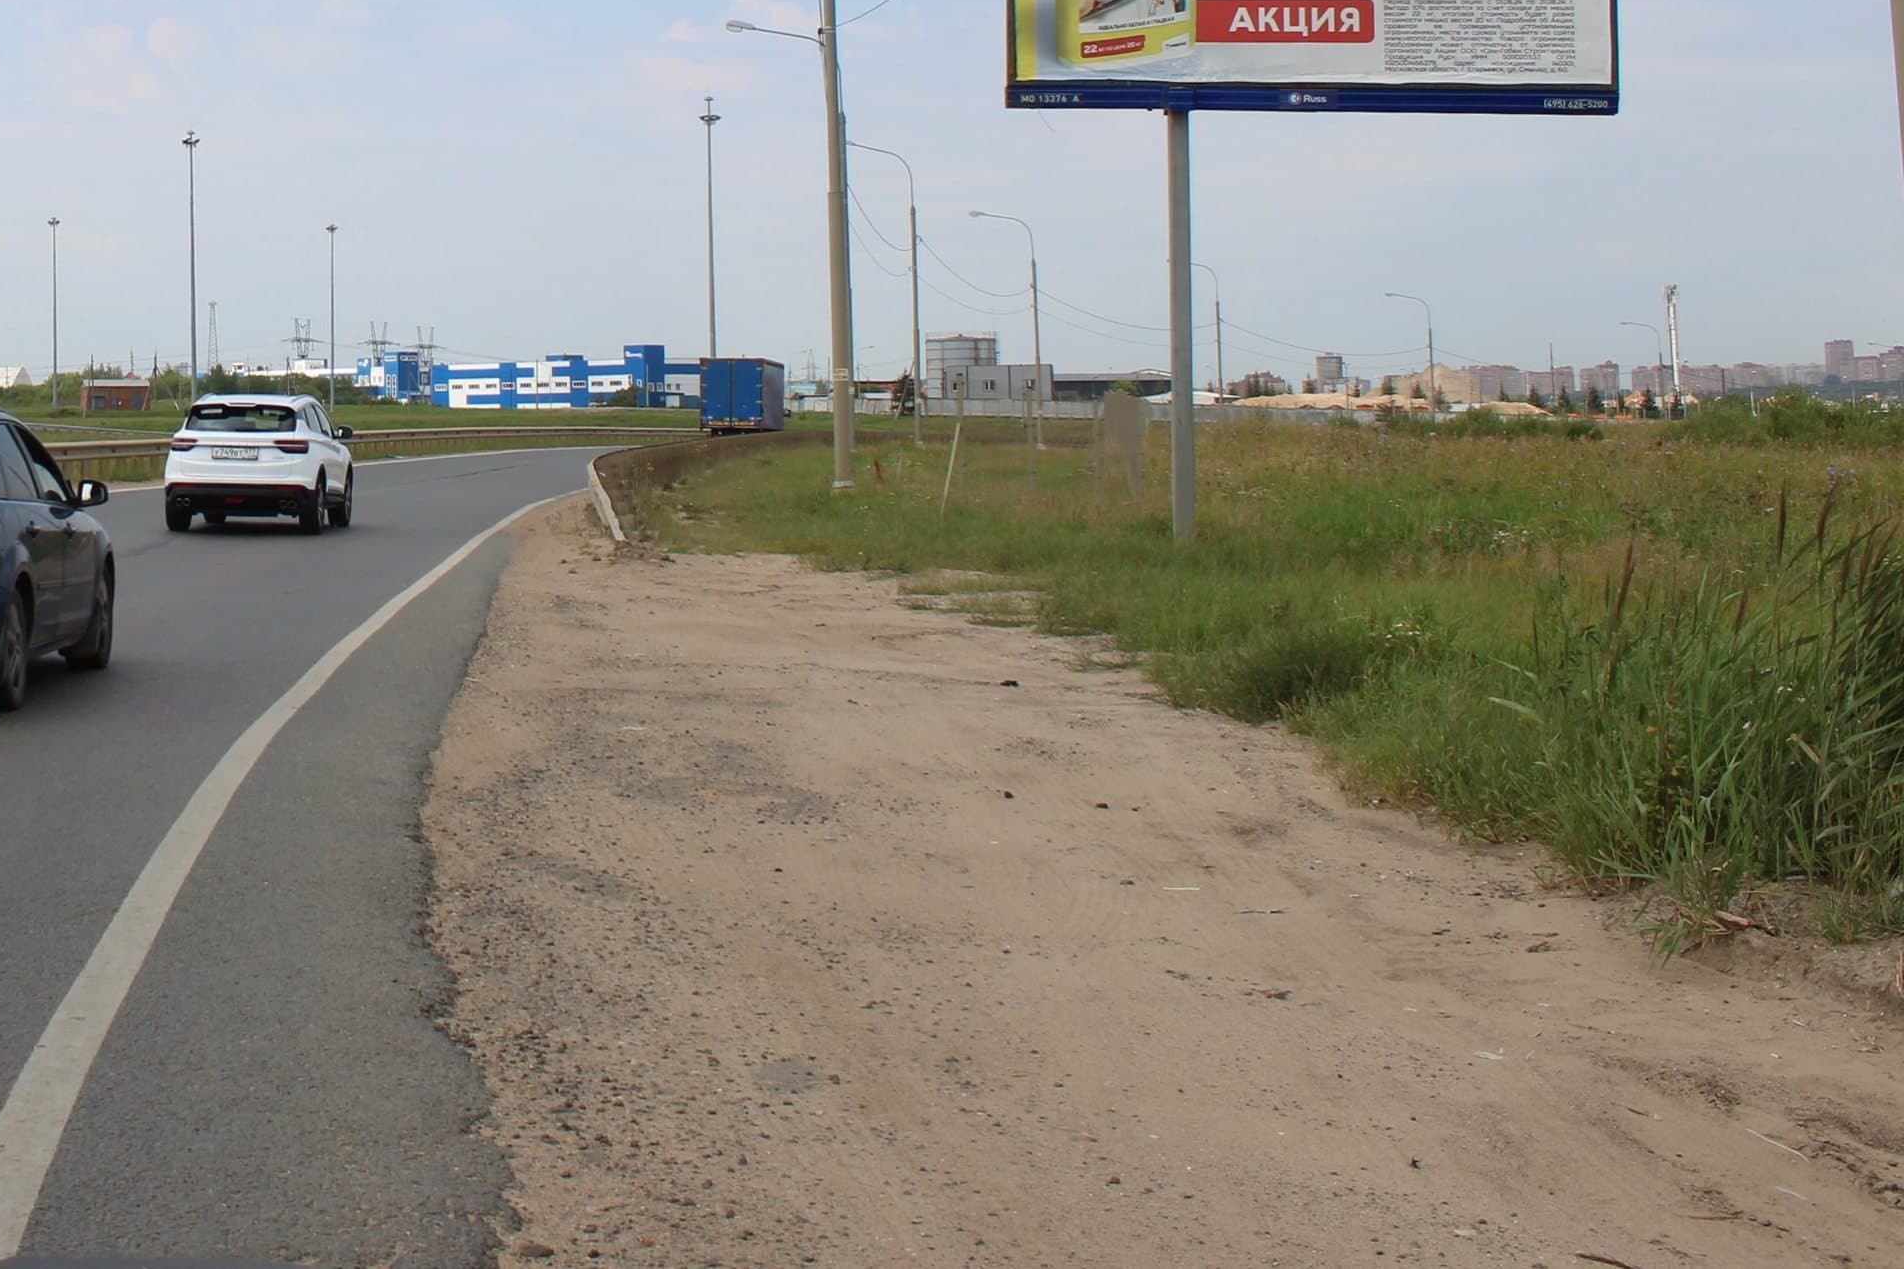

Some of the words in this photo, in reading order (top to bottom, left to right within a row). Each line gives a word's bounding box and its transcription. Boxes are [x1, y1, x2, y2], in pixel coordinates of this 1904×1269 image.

[1228, 6, 1361, 37] АКЦИЯ
[1083, 44, 1098, 54] 22
[1303, 94, 1328, 103] Russ
[1543, 98, 1566, 108] (495)
